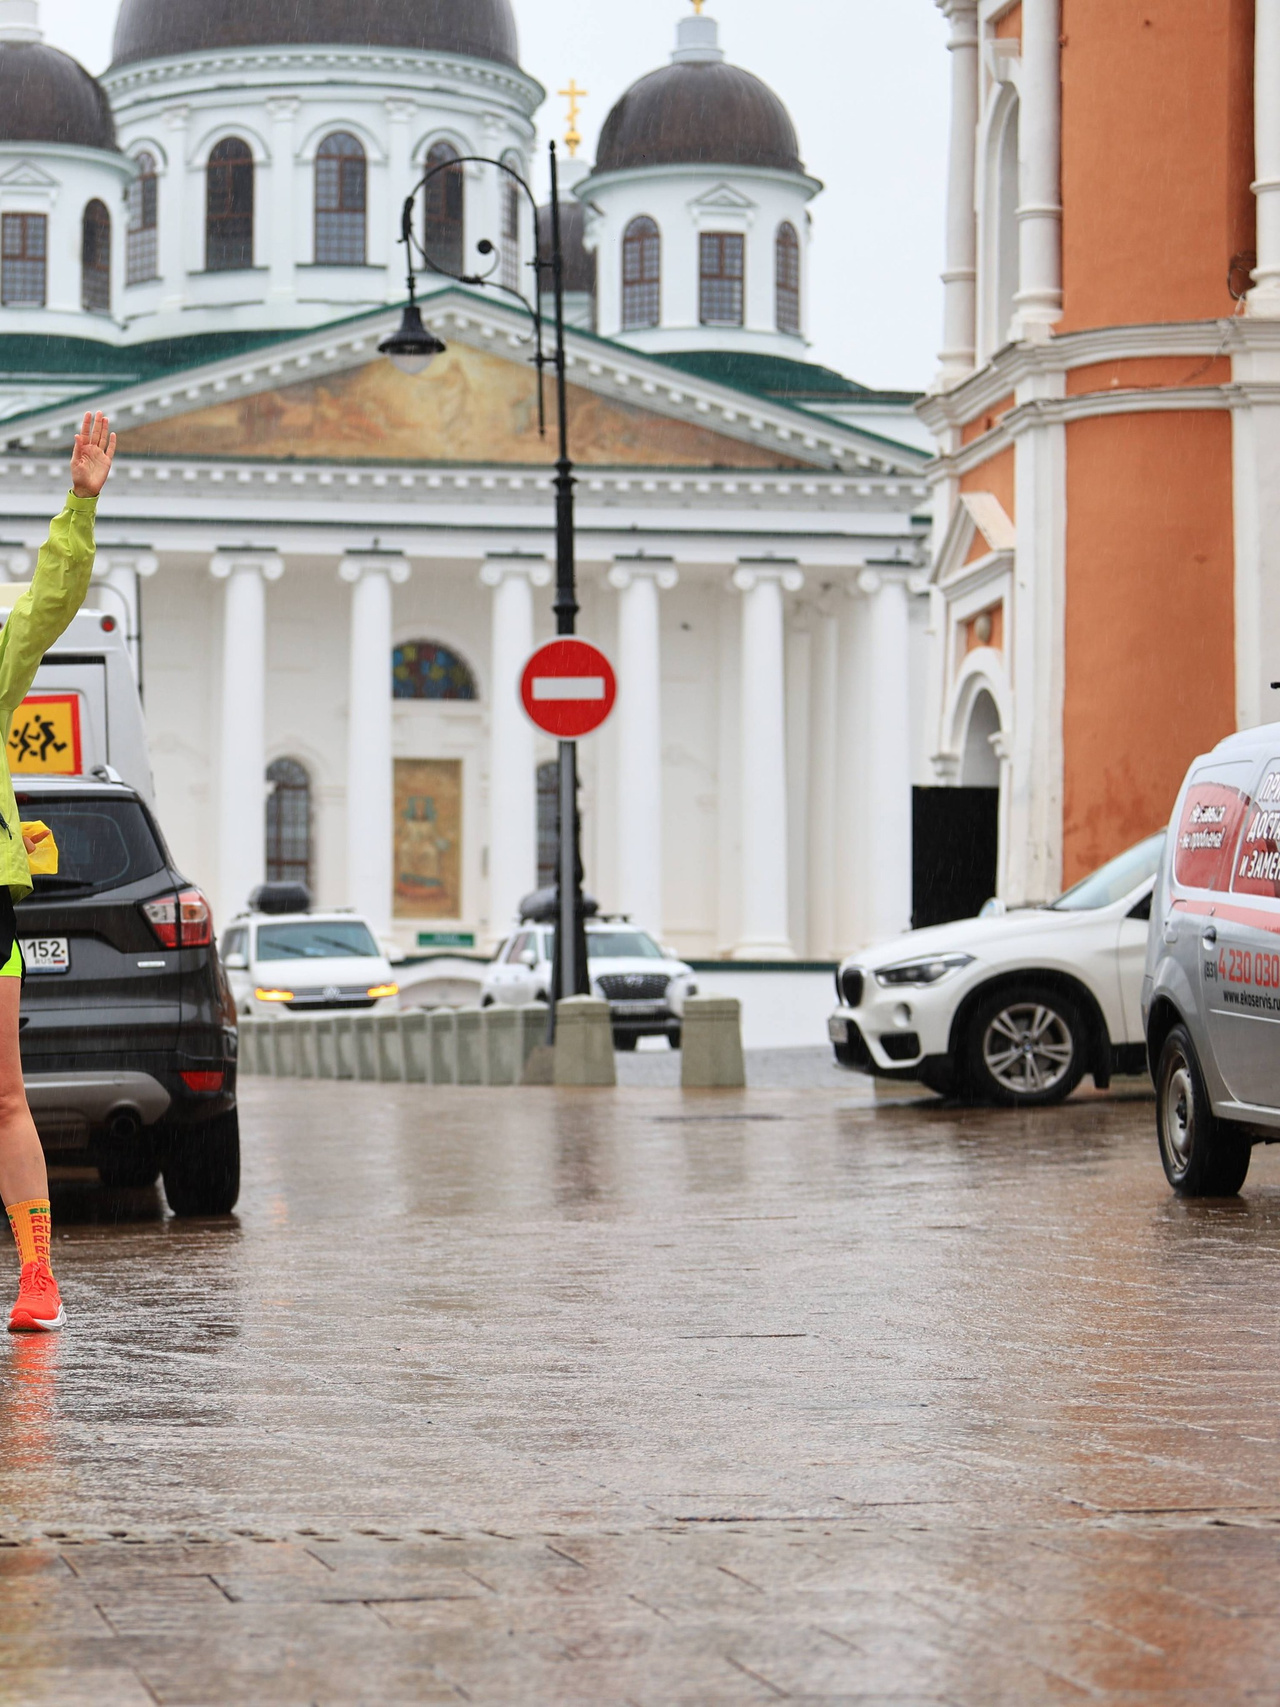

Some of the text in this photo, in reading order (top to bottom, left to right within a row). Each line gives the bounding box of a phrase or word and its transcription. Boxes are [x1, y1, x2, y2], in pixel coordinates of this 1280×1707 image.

[27, 940, 62, 958] 152
[1218, 947, 1227, 980] 4
[1228, 948, 1252, 985] 230
[1255, 951, 1280, 989] 030
[1222, 989, 1280, 1012] www.ekoservis.ru
